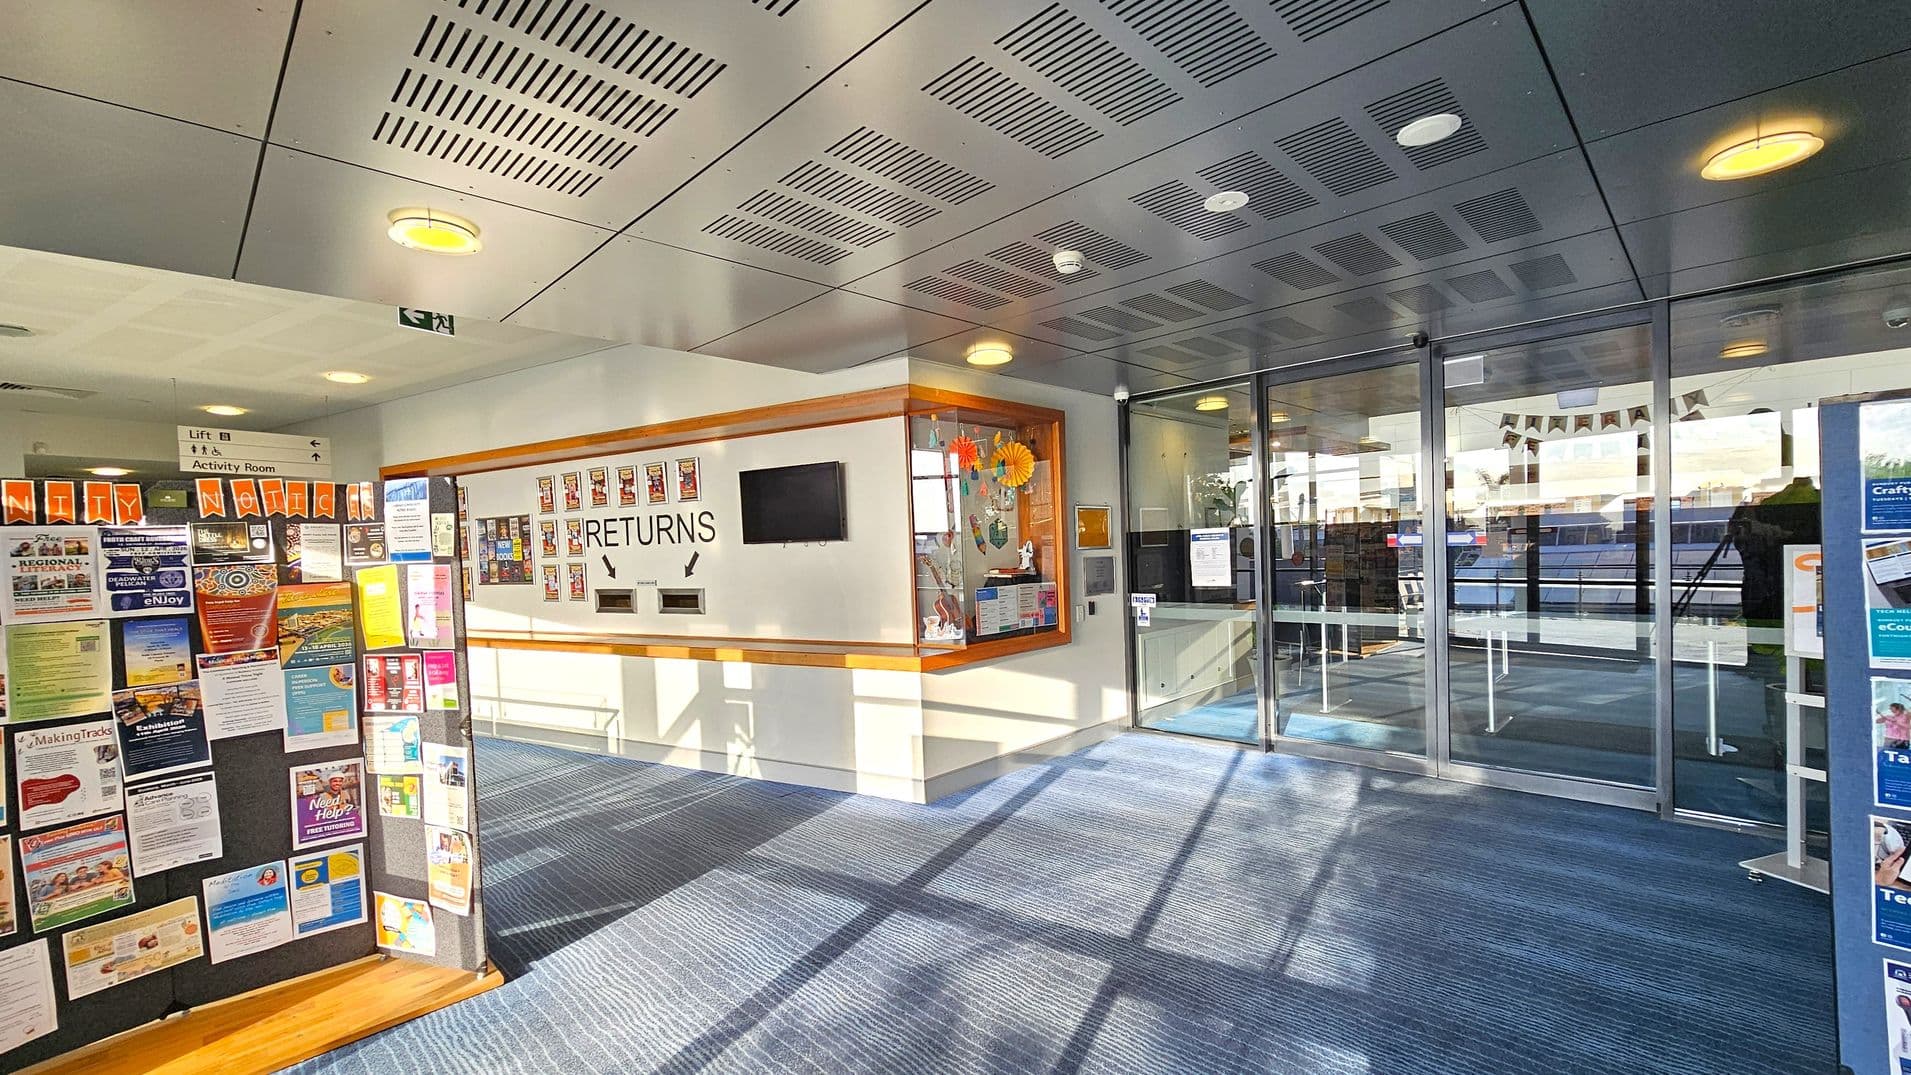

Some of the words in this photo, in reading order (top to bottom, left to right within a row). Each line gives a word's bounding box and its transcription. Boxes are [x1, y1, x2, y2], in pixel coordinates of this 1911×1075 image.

[1504, 393, 1700, 427] LITERAY
[189, 430, 212, 440] Lift
[192, 460, 240, 472] Activity
[245, 463, 276, 473] Room
[586, 511, 716, 548] RETURNS
[19, 558, 82, 567] REGIONAL
[19, 564, 81, 573] LITERACY
[108, 575, 156, 583] DEADWATER
[136, 718, 185, 732] Exhibition
[144, 792, 174, 802] Advance
[309, 795, 341, 811] Need
[314, 804, 354, 821] Help?
[306, 827, 324, 835] FREE
[324, 821, 355, 832] TUTORING
